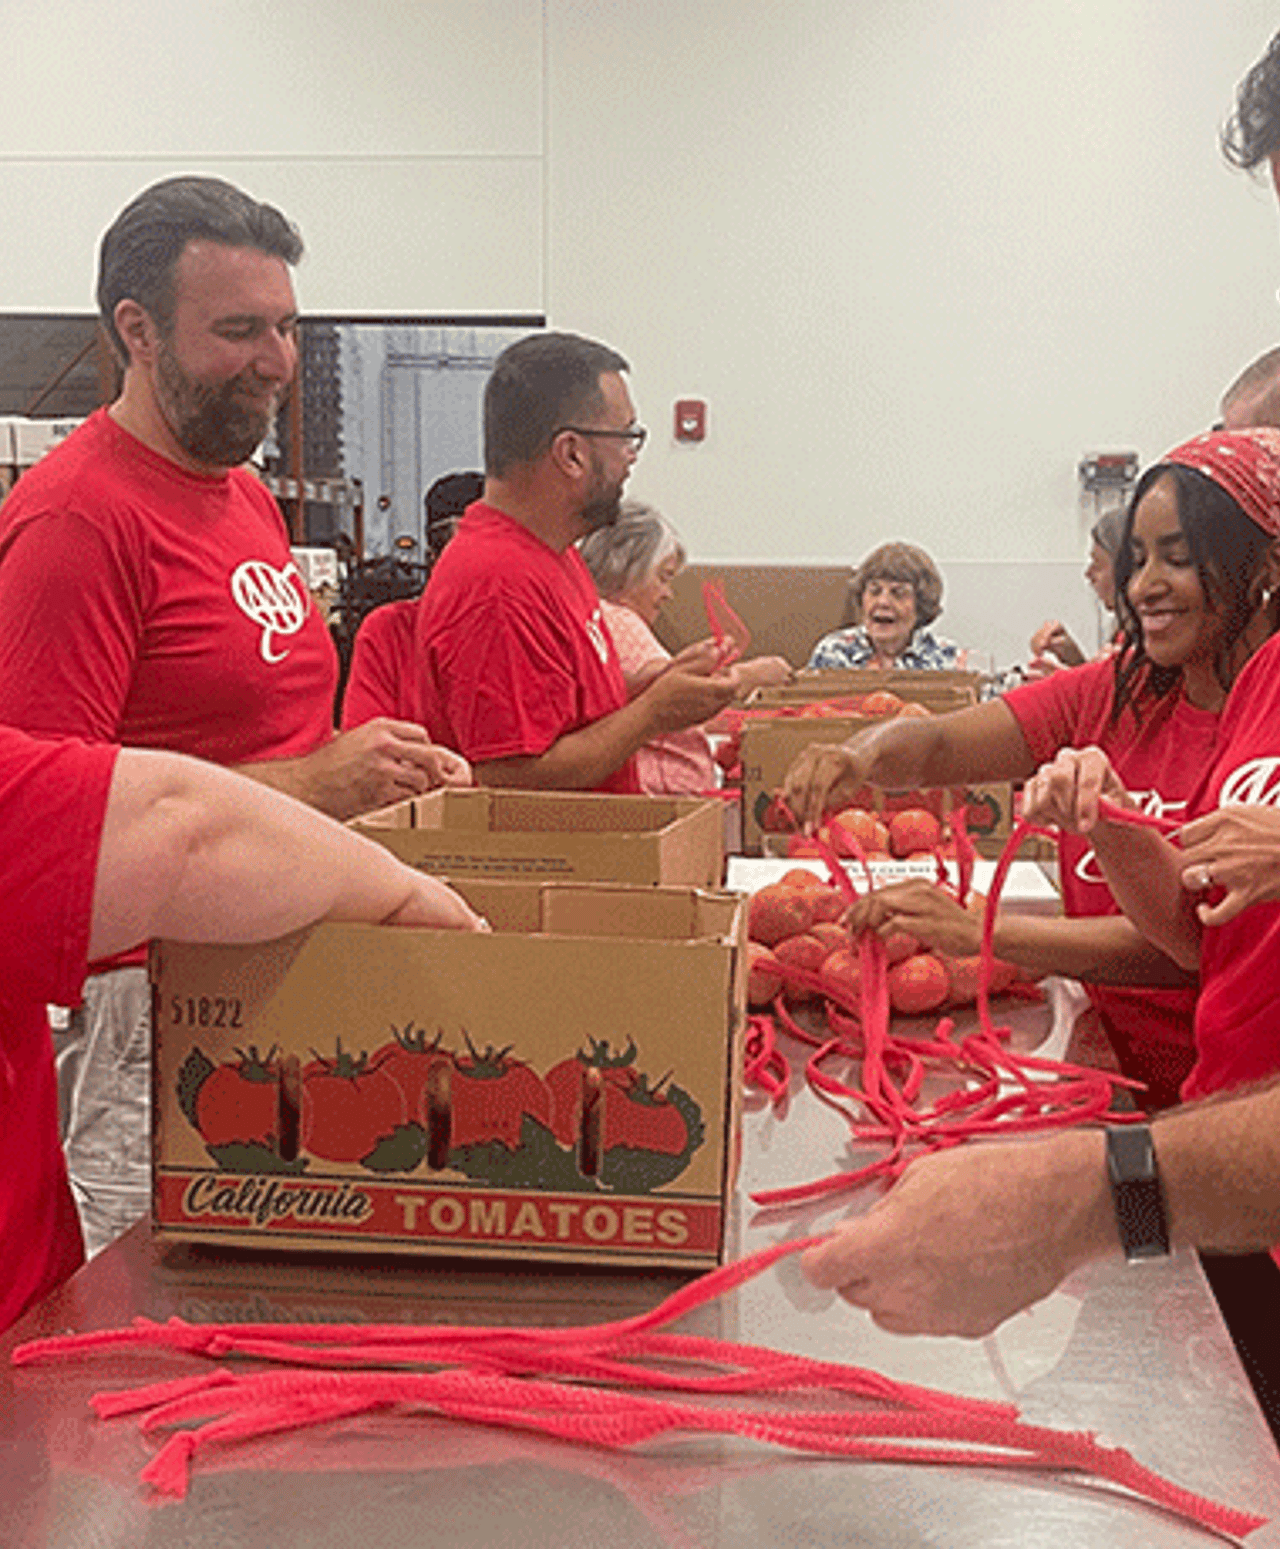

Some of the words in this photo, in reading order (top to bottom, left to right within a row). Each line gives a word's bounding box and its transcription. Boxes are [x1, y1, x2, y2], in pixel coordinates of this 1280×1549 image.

[232, 560, 306, 634] AAA
[170, 994, 243, 1028] 51822
[184, 1177, 372, 1227] California
[396, 1195, 690, 1245] TOMATOES
